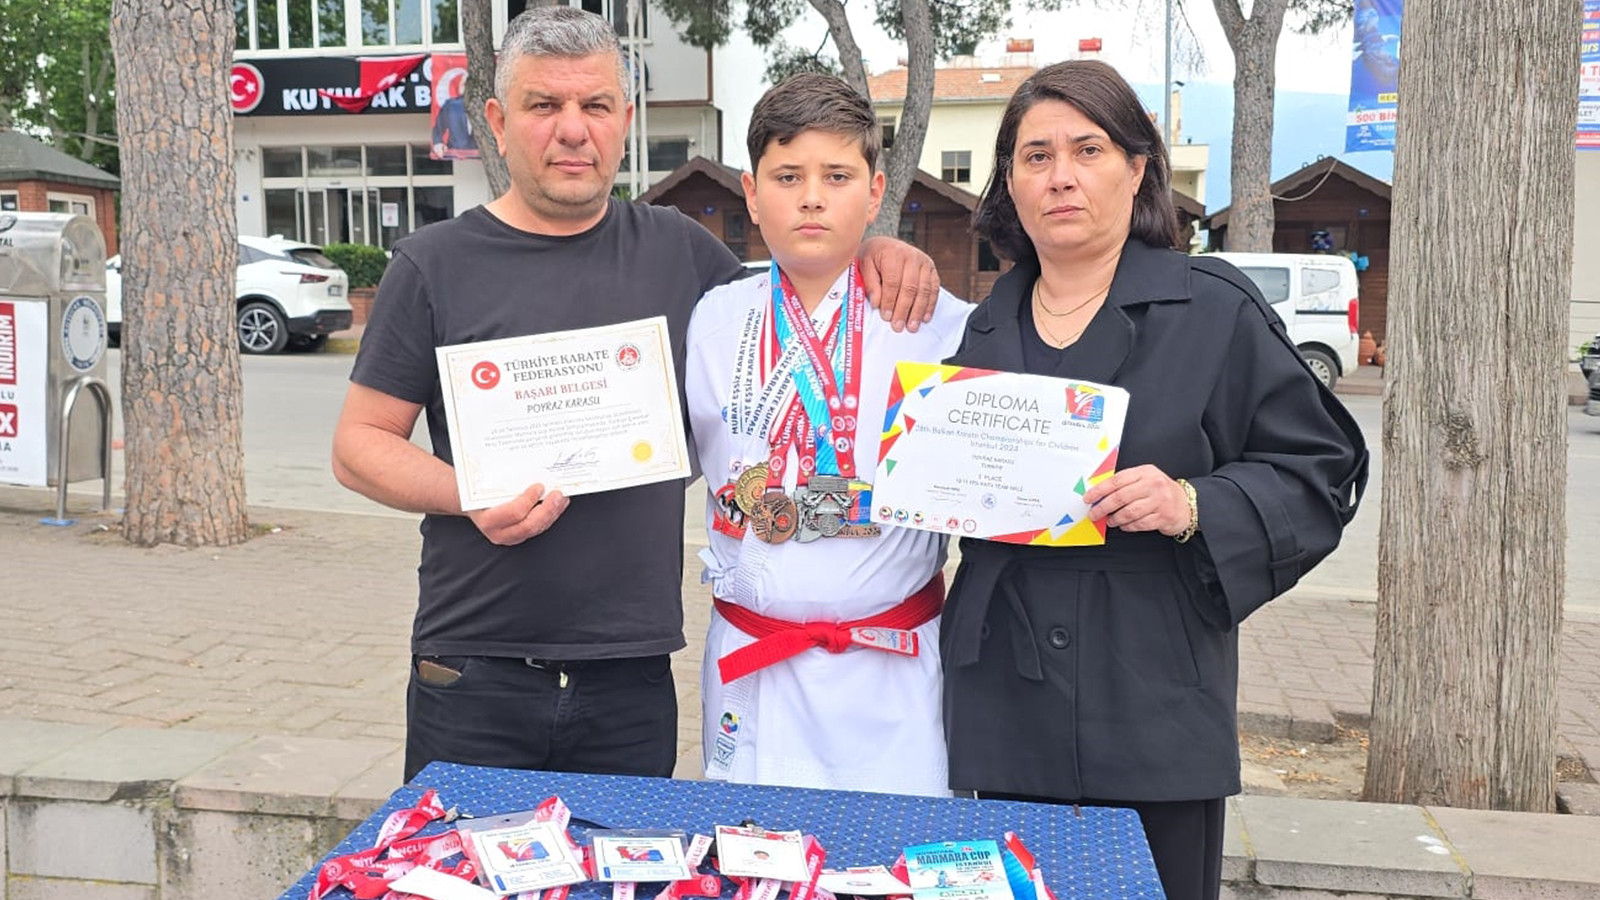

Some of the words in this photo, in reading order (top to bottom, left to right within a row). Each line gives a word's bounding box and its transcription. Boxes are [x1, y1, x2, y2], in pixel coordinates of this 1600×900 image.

[503, 354, 559, 372] TÜRKİYE
[560, 350, 610, 365] KARATE
[736, 340, 747, 372] KARATE
[513, 362, 604, 382] FEDERASYONU
[514, 386, 557, 400] BAŞARI
[561, 379, 608, 394] BELGESİ
[760, 367, 784, 402] KARATE
[774, 371, 793, 406] KARATE
[527, 399, 563, 414] POYRAZ
[565, 396, 601, 410] KARASU
[965, 391, 1039, 413] DIPLOMA
[746, 403, 764, 436] KUPASI
[759, 405, 775, 439] KUPASI
[948, 409, 1051, 435] CERTIFICATE
[916, 852, 968, 865] MARMARA
[970, 851, 991, 861] CUP
